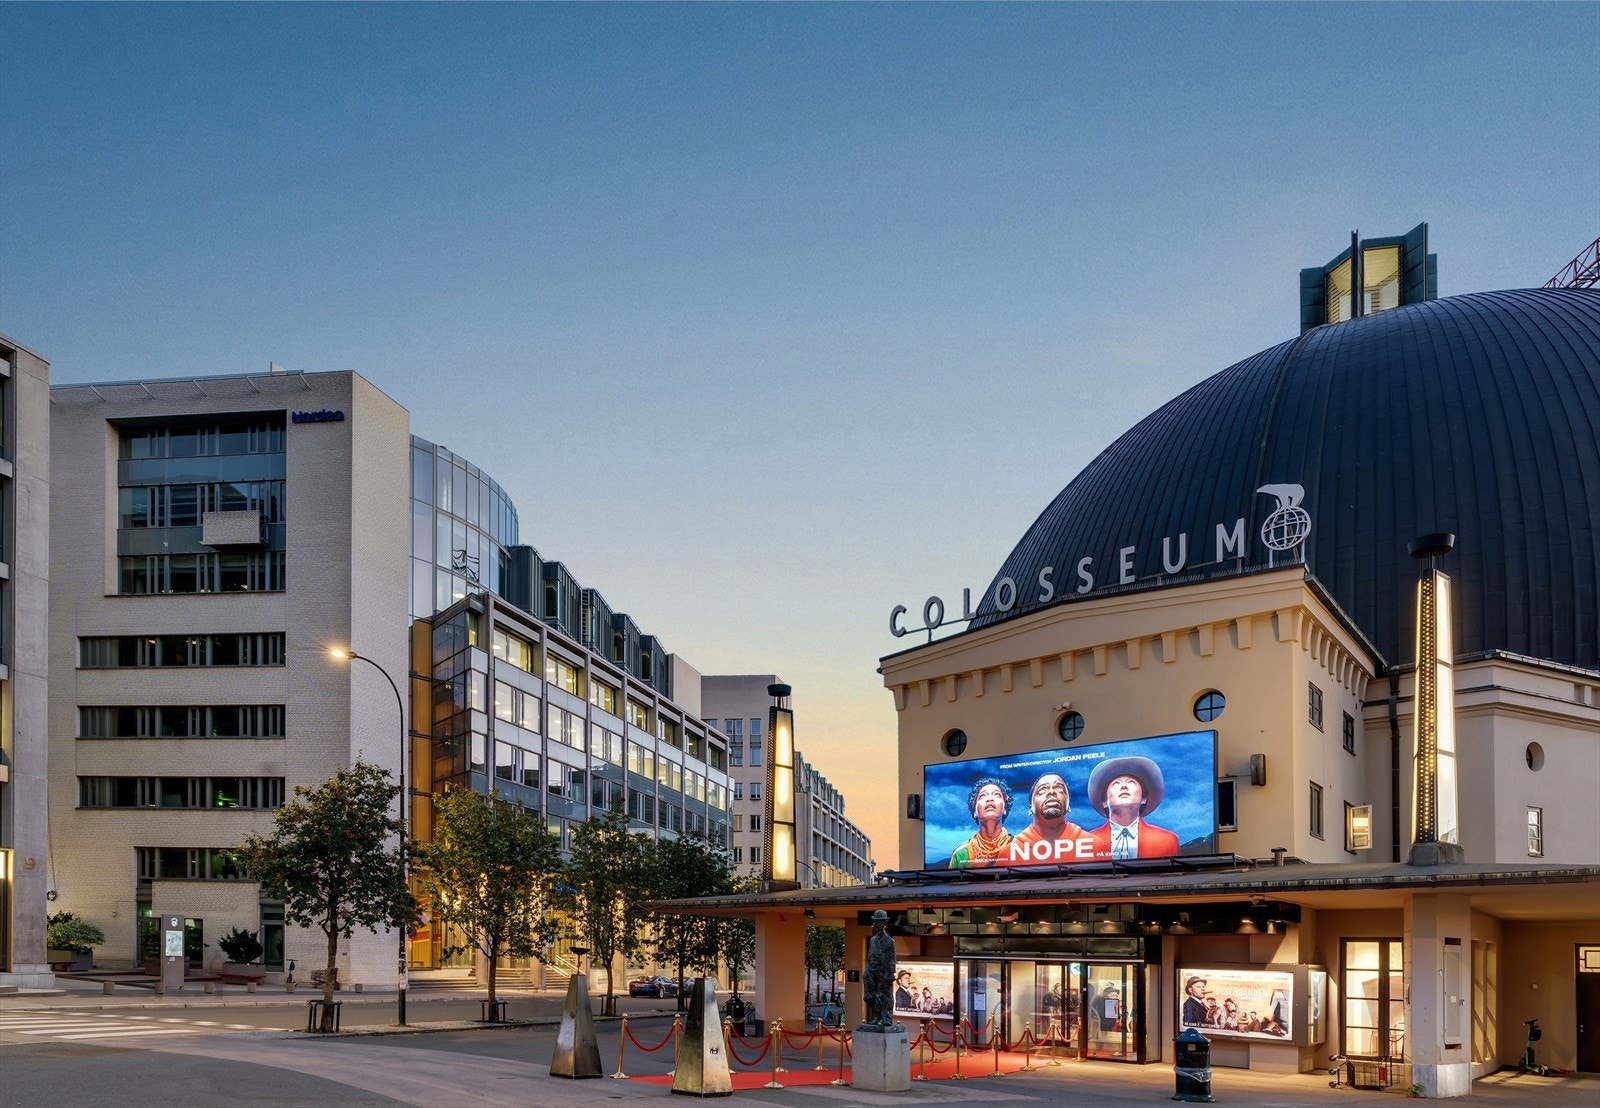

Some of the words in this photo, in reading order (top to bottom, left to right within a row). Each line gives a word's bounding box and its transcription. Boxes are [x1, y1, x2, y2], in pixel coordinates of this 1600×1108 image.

[889, 518, 1245, 638] COLOSSEUM
[1053, 755, 1081, 763] JORDAN
[1082, 752, 1105, 760] PEELE
[1010, 838, 1094, 861] NOPE
[24, 856, 36, 870] 9
